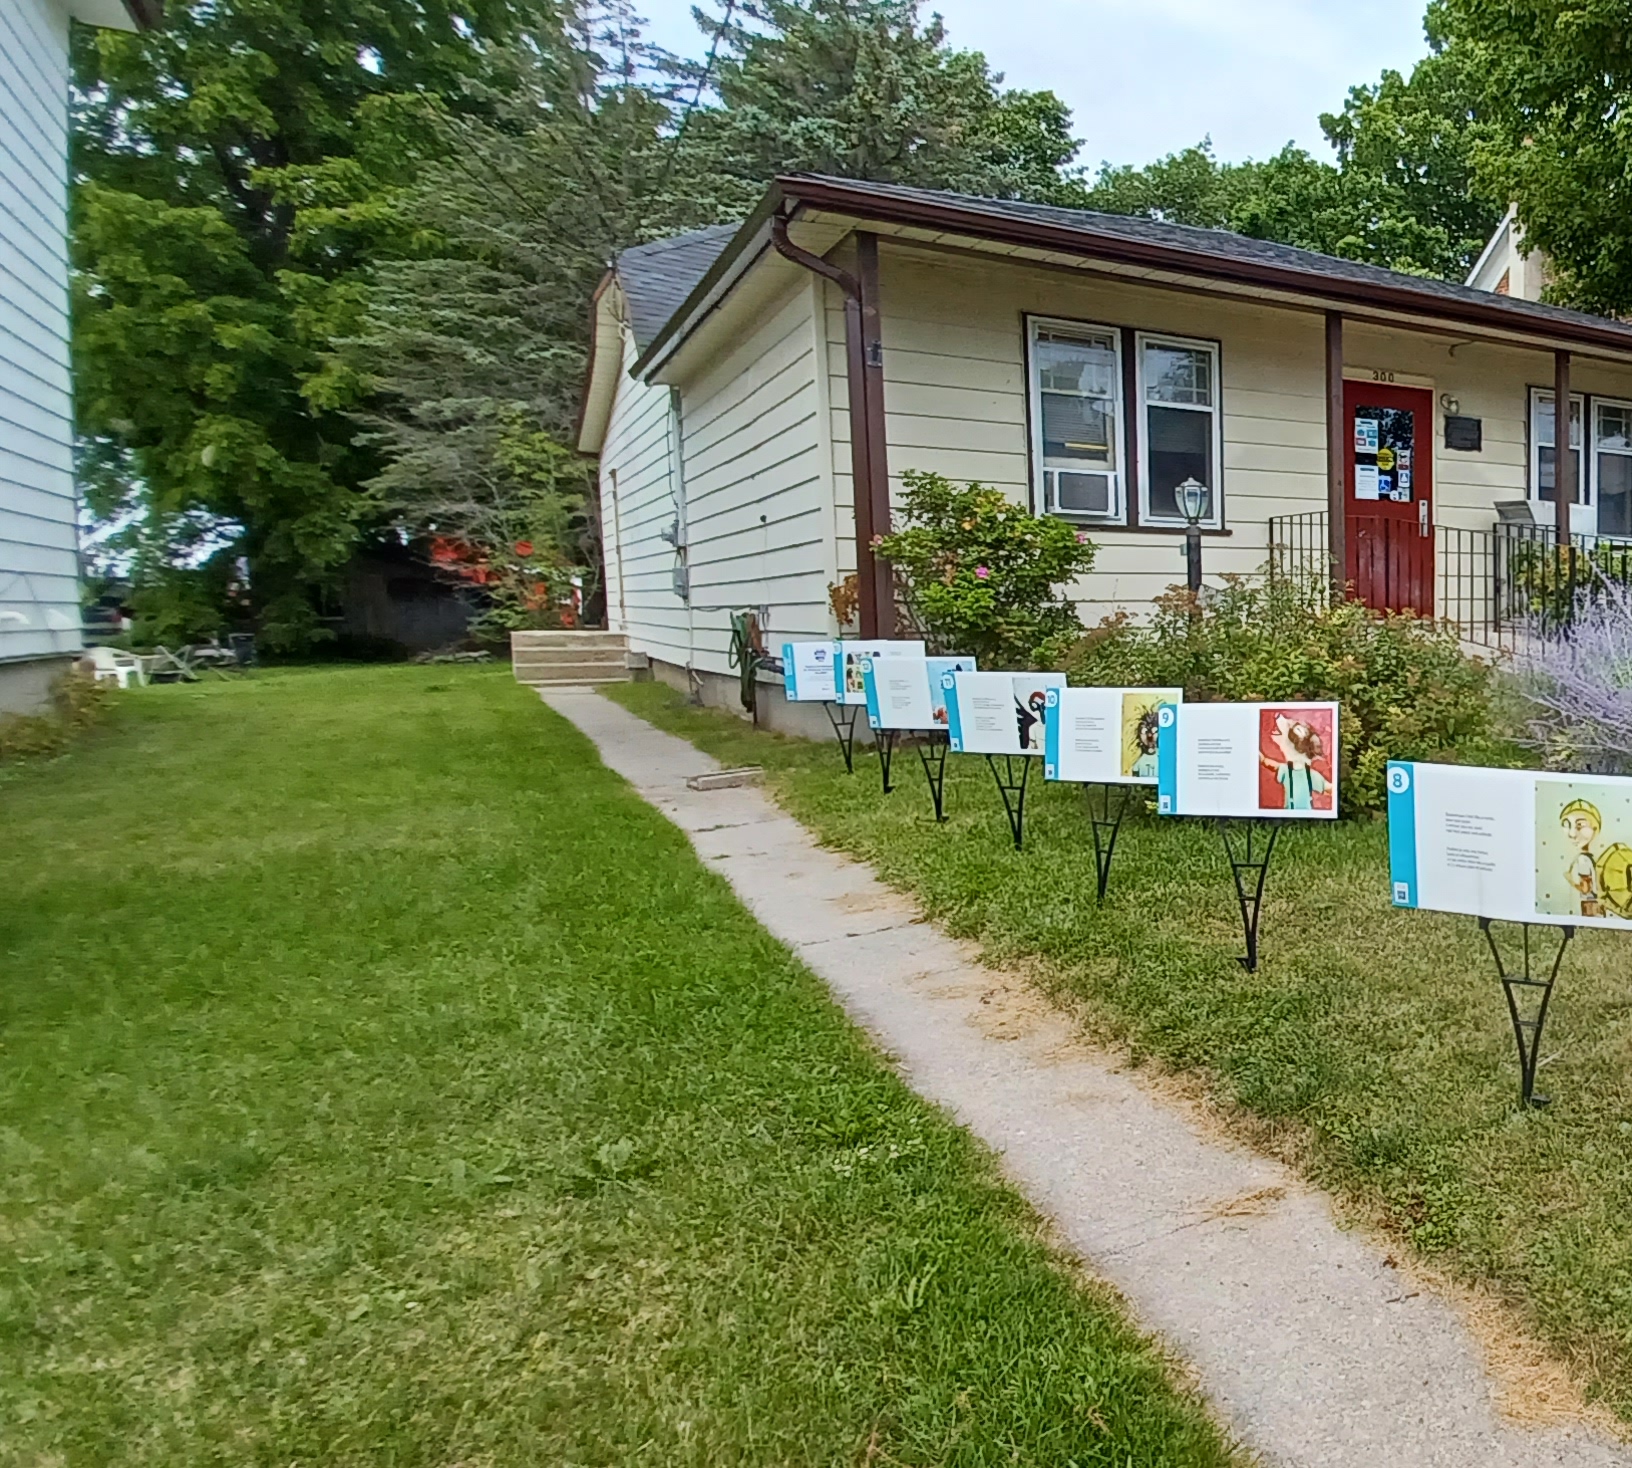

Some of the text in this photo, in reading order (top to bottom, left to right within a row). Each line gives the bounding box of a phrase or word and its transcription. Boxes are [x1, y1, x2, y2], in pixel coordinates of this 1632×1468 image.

[1372, 370, 1394, 383] 300
[1047, 694, 1056, 705] 10
[1162, 712, 1170, 724] 9
[1392, 772, 1403, 788] 8
